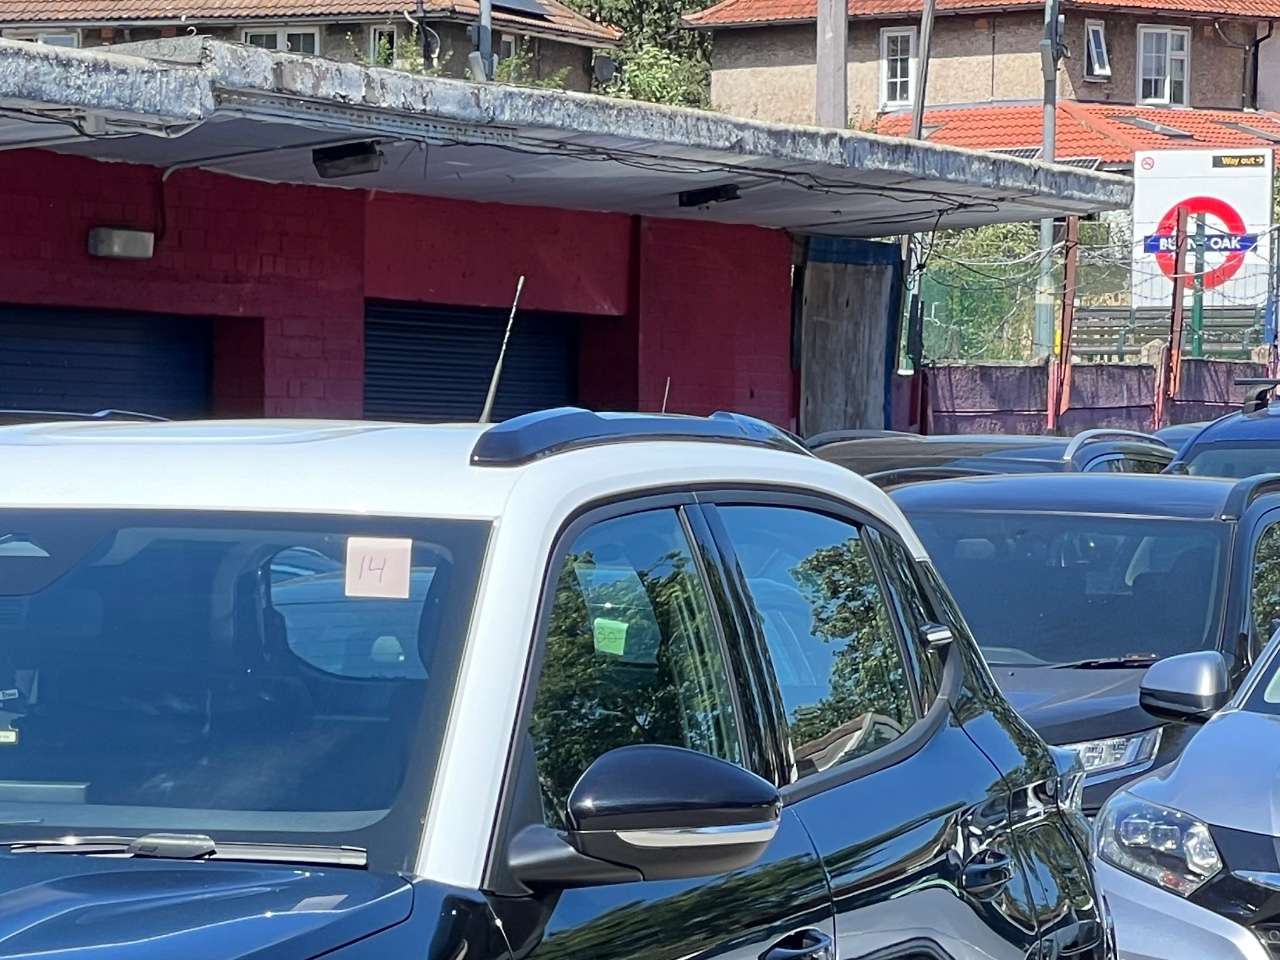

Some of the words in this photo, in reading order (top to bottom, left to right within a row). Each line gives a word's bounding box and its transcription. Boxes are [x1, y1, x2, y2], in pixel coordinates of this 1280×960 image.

[1221, 156, 1240, 166] Way
[1240, 156, 1255, 165] out
[1209, 236, 1241, 249] OAK
[359, 554, 387, 585] 14
